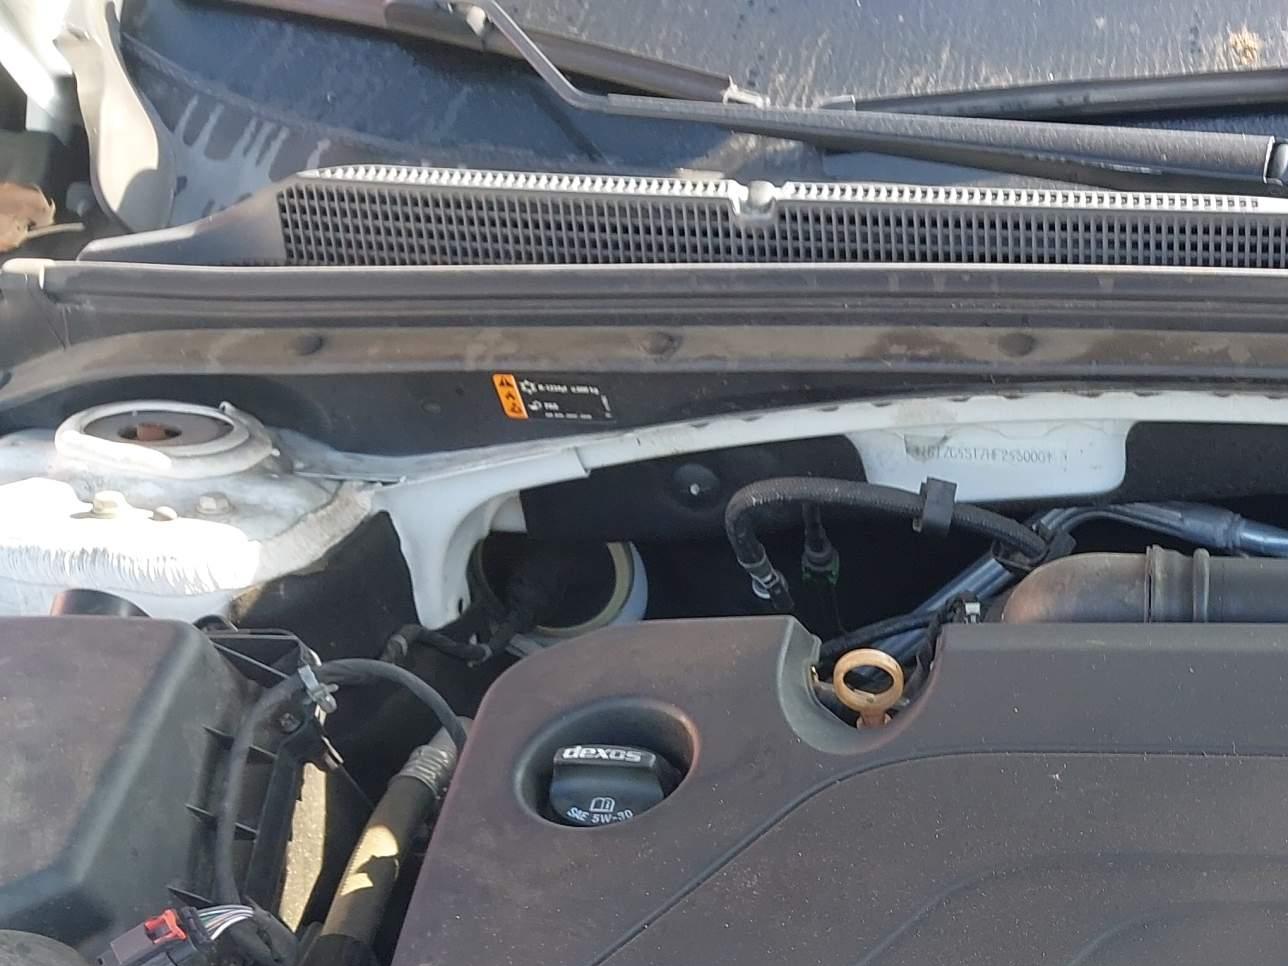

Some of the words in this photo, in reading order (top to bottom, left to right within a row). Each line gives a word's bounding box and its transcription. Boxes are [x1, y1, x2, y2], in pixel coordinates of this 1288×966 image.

[562, 745, 641, 763] dexos
[566, 807, 589, 822] SAE
[591, 810, 633, 824] 5W-30
